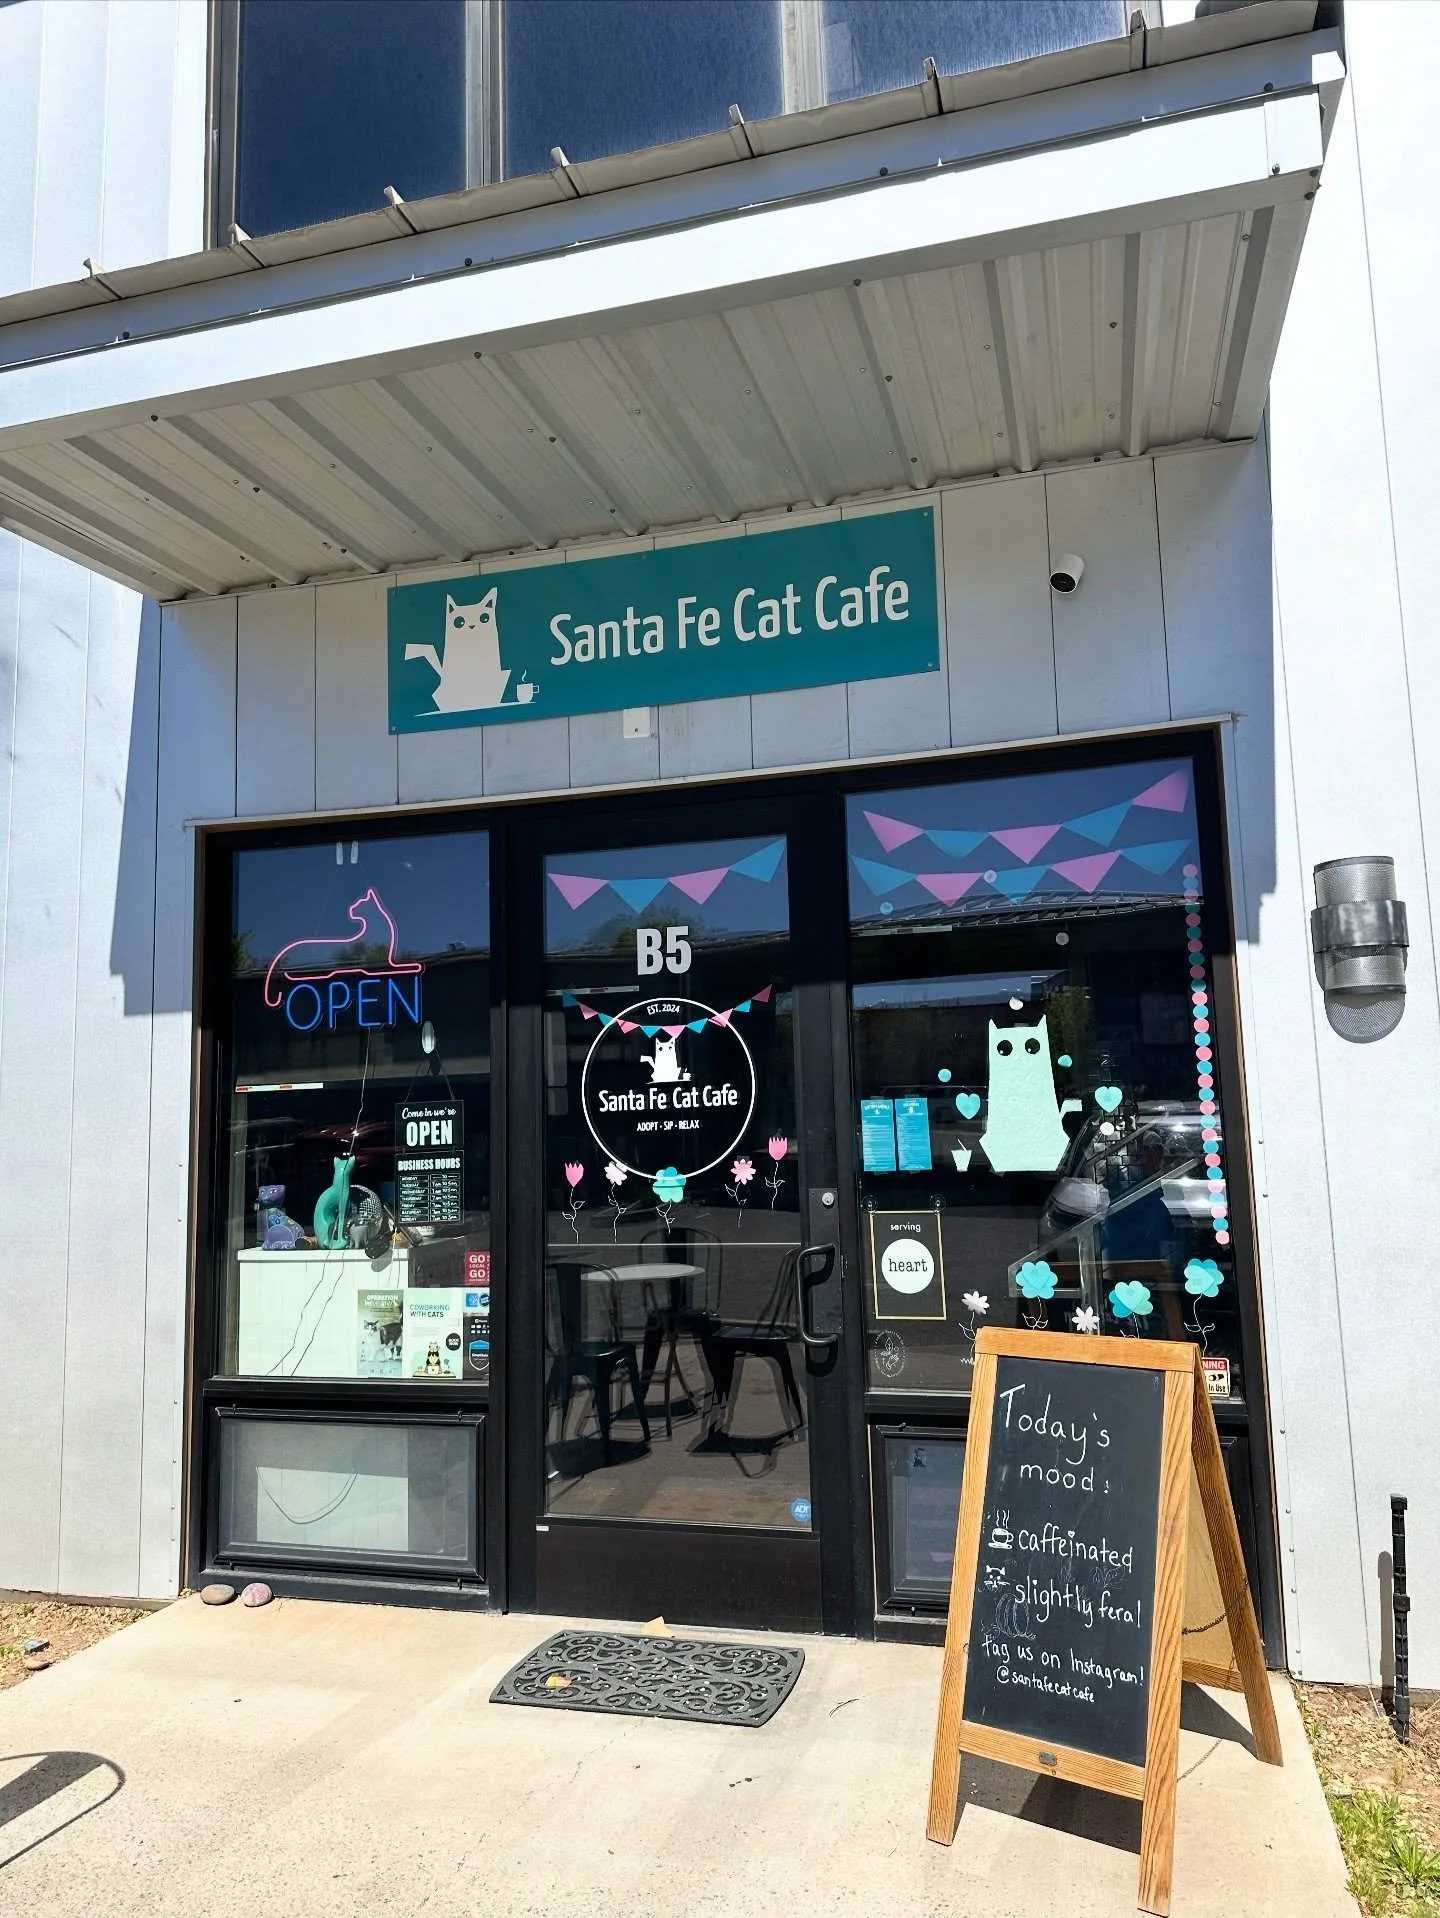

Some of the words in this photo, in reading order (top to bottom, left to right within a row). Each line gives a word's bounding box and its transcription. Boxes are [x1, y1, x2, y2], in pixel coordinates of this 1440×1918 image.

[551, 605, 664, 666] Santa
[679, 597, 721, 649] Fe
[734, 583, 802, 641] Cat
[815, 565, 910, 630] Cafe
[636, 926, 692, 976] B5
[286, 977, 421, 1030] OPEN
[598, 1090, 645, 1112] Santa
[650, 1088, 667, 1110] Fe
[672, 1086, 700, 1108] Cat
[702, 1084, 738, 1106] Cafe
[402, 1108, 424, 1120] Come
[434, 1106, 456, 1116] we're
[406, 1120, 452, 1146] OPEN
[636, 1122, 658, 1132] ADOPT
[664, 1121, 674, 1130] SIP
[678, 1120, 700, 1130] RELAX
[398, 1159, 434, 1171] BUSINESS
[435, 1158, 460, 1170] HOURS
[890, 1222, 922, 1232] serving
[469, 1254, 486, 1263] GO
[888, 1258, 928, 1272] heart
[469, 1269, 486, 1278] GO
[1202, 1360, 1225, 1370] NING
[1216, 1384, 1226, 1392] Use
[1000, 1384, 1110, 1465] Today's
[794, 1504, 810, 1514] ADT
[1018, 1522, 1133, 1574] caffeinated
[1014, 1575, 1094, 1628] slightly
[1098, 1590, 1141, 1628] feral
[1017, 1645, 1033, 1660] us
[1041, 1651, 1060, 1668] on
[1070, 1648, 1144, 1688] Instagram!
